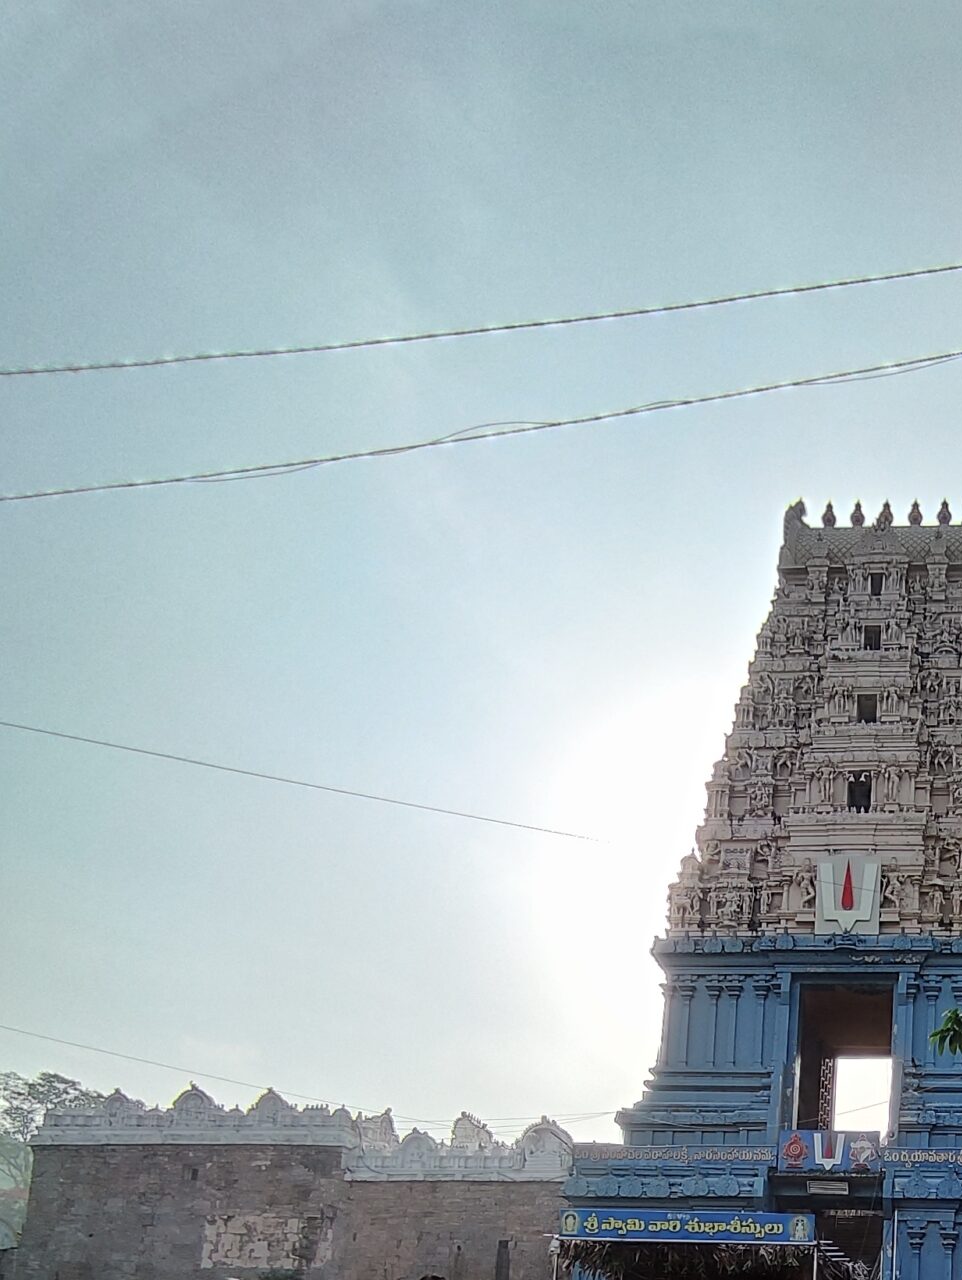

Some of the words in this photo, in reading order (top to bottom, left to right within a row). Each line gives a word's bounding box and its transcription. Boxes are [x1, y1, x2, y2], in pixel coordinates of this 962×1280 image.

[884, 1150, 898, 1162] ఓం
[583, 1213, 599, 1234] శ్రీ
[601, 1217, 645, 1235] స్వామి
[648, 1218, 681, 1233] వారి
